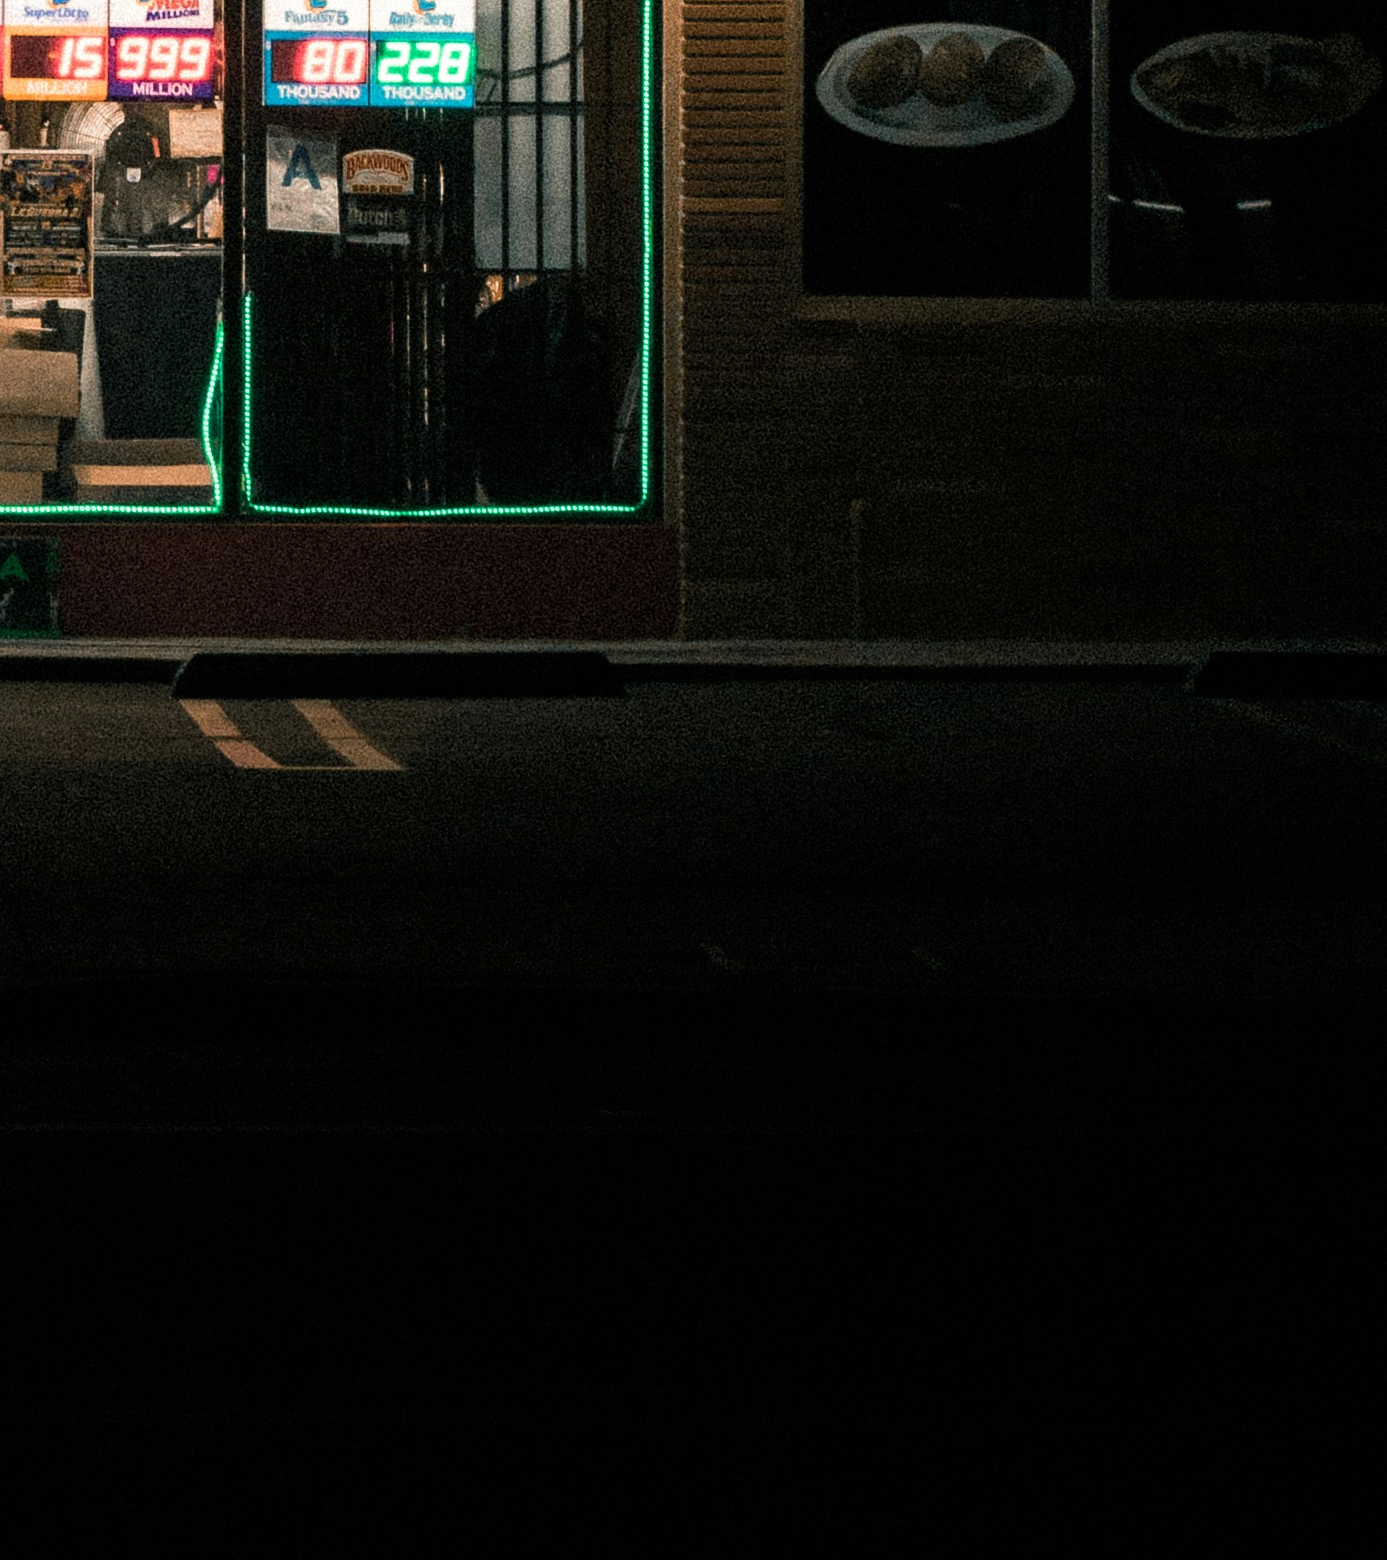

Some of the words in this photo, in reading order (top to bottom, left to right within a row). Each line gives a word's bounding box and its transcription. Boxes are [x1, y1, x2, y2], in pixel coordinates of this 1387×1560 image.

[146, 9, 200, 22] MILLIONS
[57, 36, 103, 78] 15
[117, 36, 212, 80] 999
[302, 39, 368, 82] 80
[378, 41, 471, 84] 228
[27, 81, 88, 96] MILLION
[133, 82, 193, 97] MILLION
[277, 84, 361, 100] THOUSAND
[382, 85, 466, 101] THOUSAND
[282, 143, 322, 191] A
[346, 152, 410, 181] BACKWOODS
